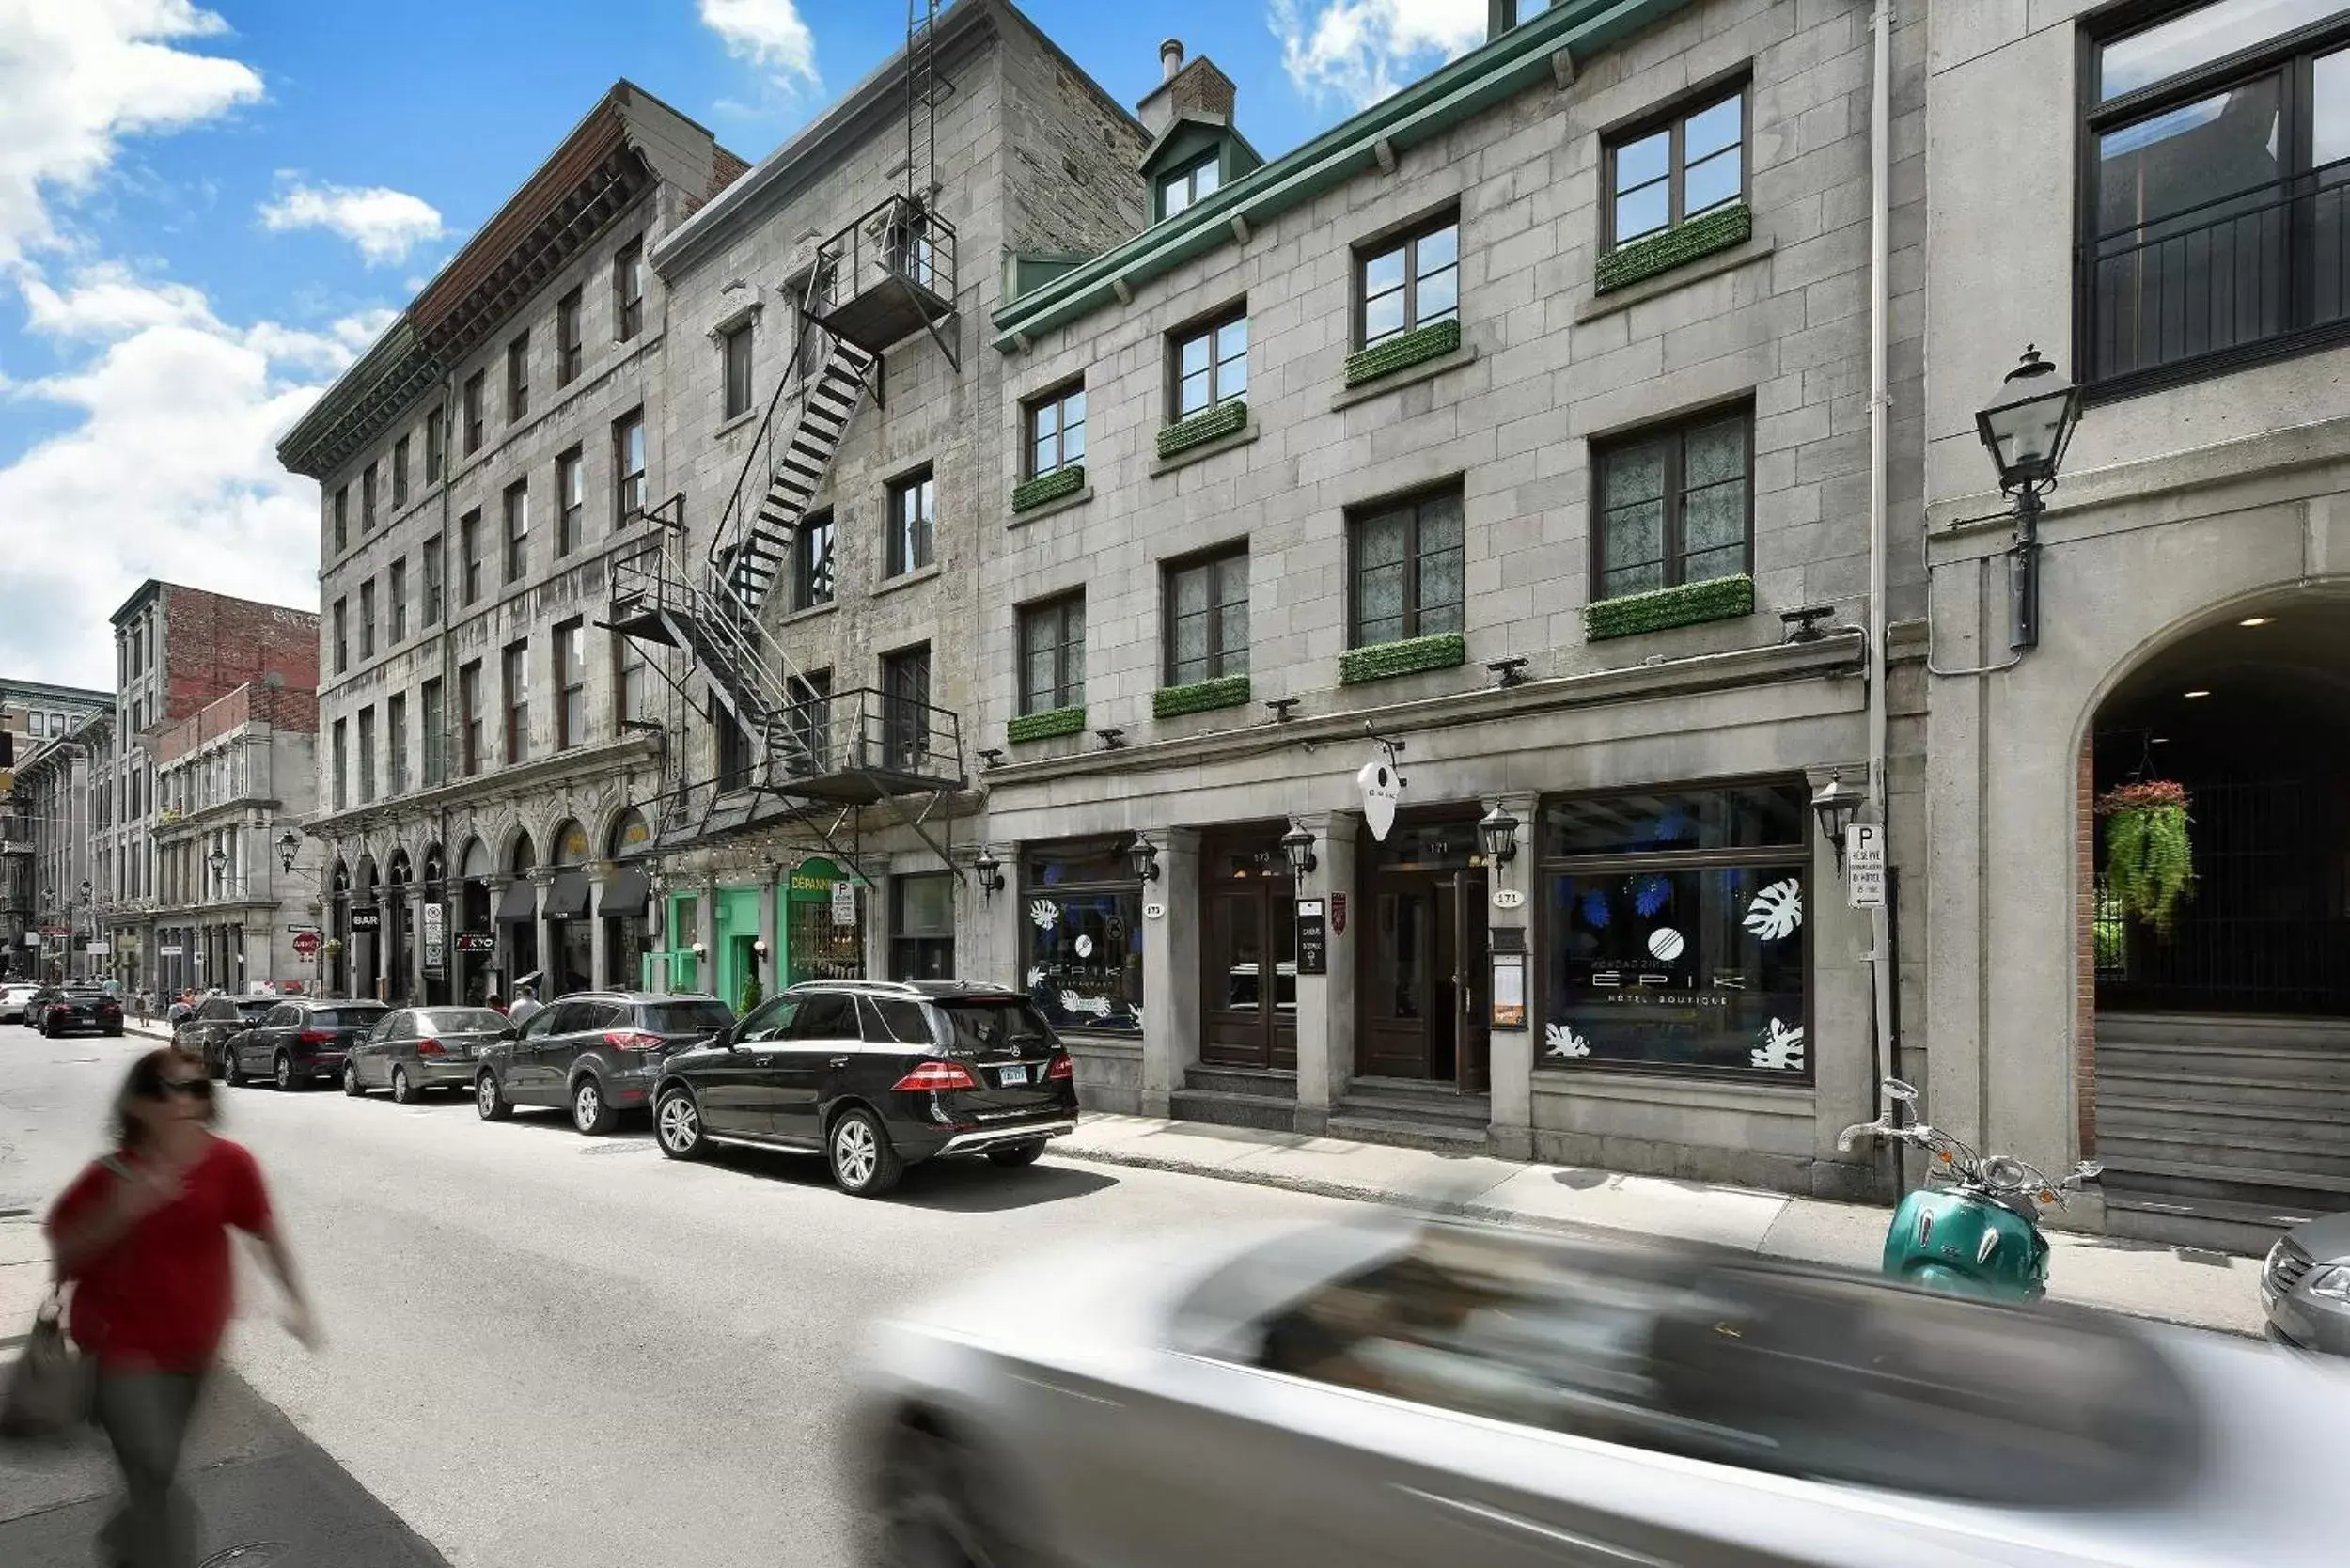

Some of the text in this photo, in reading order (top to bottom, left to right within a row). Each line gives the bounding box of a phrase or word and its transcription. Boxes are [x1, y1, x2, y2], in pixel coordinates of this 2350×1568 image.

[1860, 828, 1872, 849] P
[1431, 842, 1448, 854] 171
[839, 883, 848, 895] P
[1497, 894, 1518, 903] 171
[352, 915, 378, 925] BAR
[1607, 993, 1728, 1006] HÔTEL BOUTIQUE
